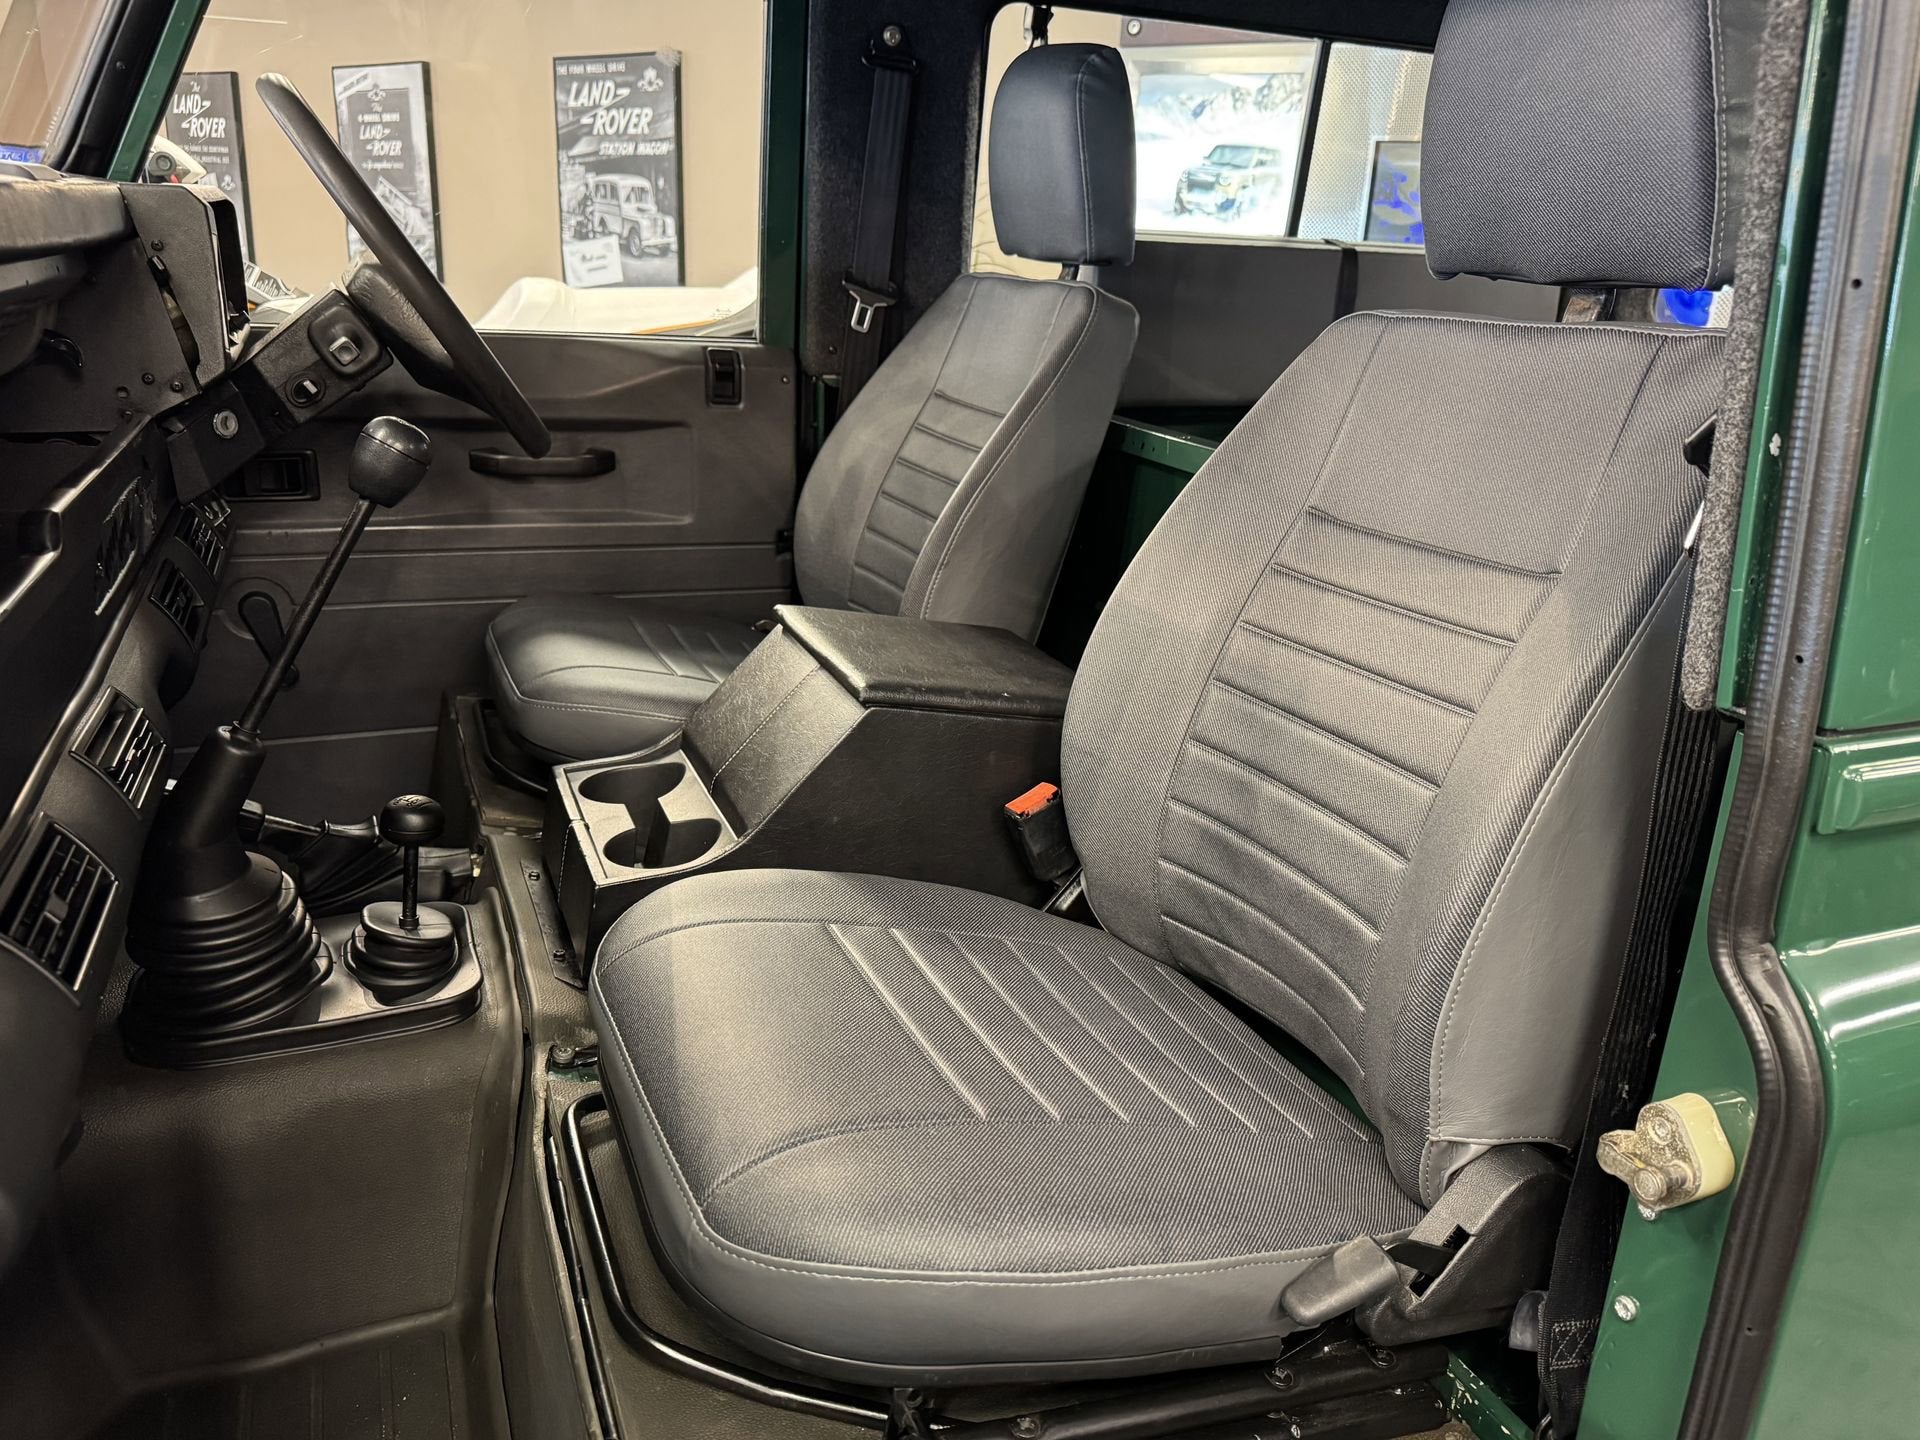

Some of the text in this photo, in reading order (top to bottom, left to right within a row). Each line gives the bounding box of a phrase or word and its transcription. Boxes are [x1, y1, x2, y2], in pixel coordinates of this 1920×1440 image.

[173, 94, 201, 114] LAND
[568, 80, 615, 107] LAND
[189, 117, 226, 139] ROVER
[593, 107, 653, 135] ROVER
[372, 141, 402, 156] ROVER
[599, 141, 635, 156] STATION
